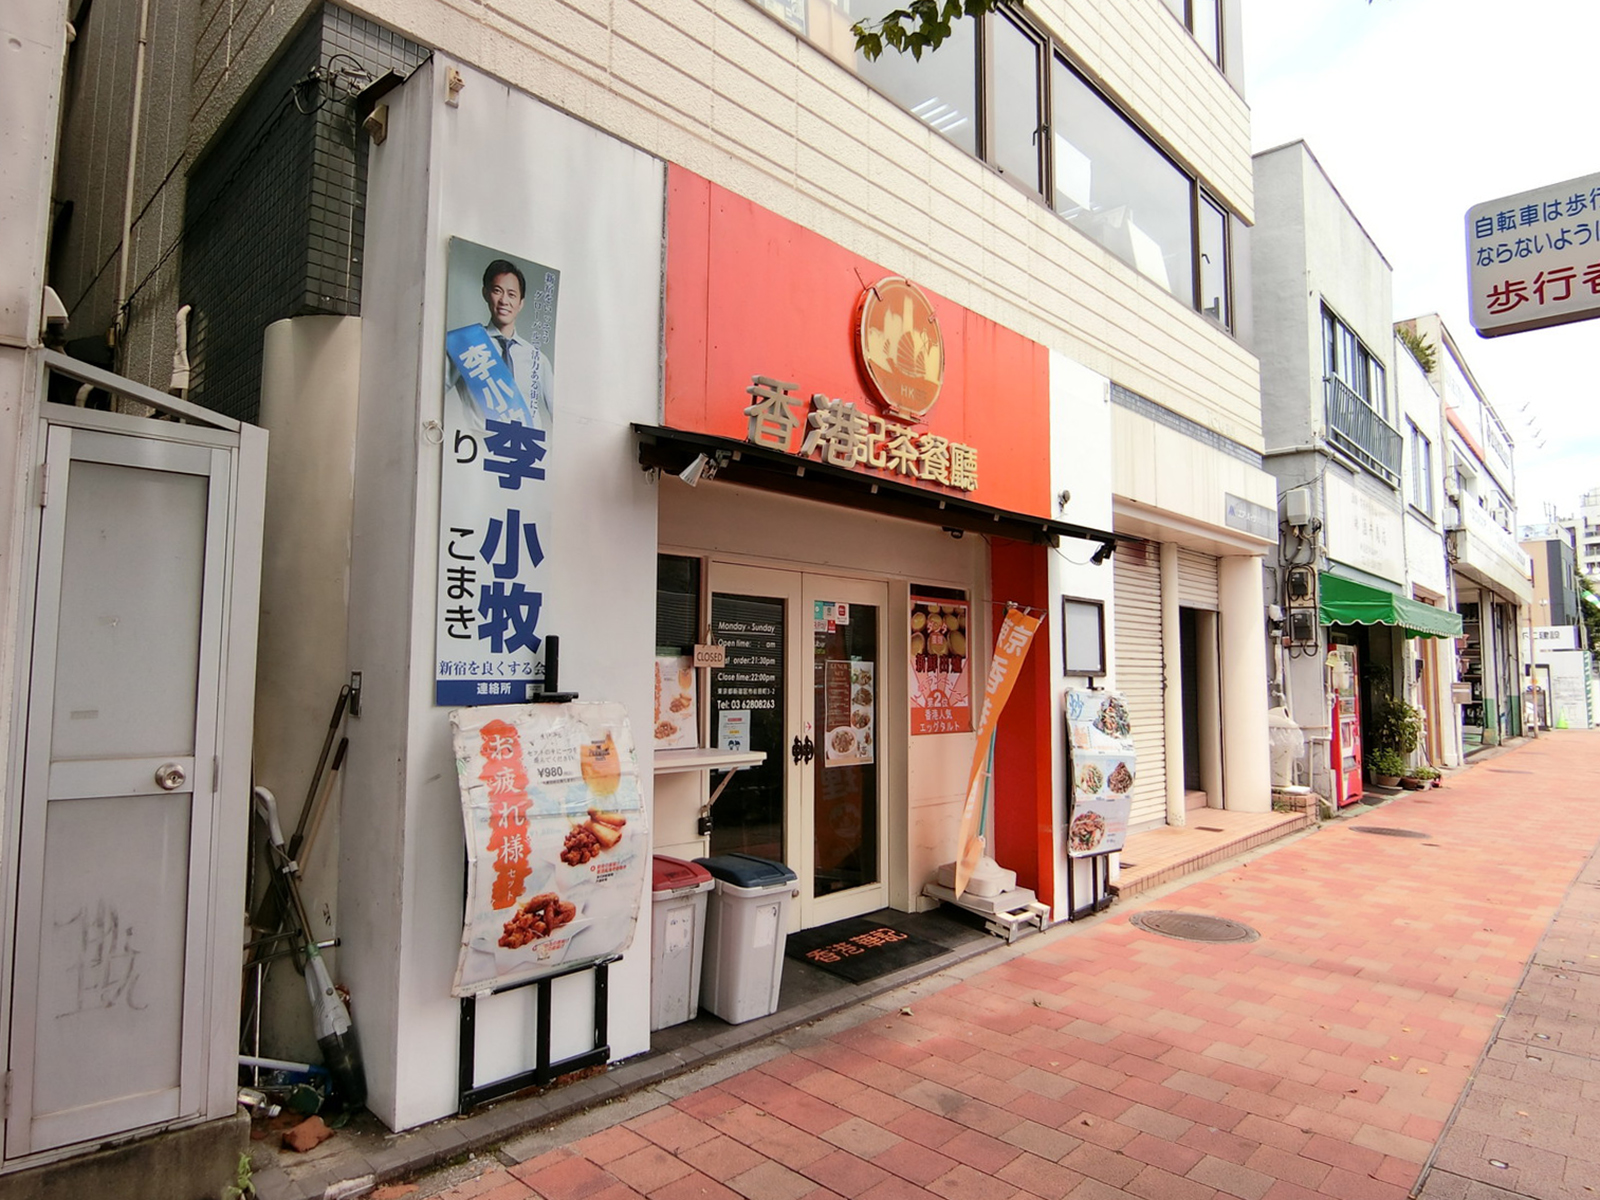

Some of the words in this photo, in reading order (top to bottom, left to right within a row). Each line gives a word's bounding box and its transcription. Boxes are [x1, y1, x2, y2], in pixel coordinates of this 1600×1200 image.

[1476, 220, 1600, 267] ならないよう
[900, 384, 915, 400] HK
[454, 429, 478, 464] り
[444, 527, 477, 639] こまき
[719, 621, 747, 632] Monday
[751, 623, 776, 634] Sunday
[717, 638, 736, 648] Open
[696, 651, 723, 663] CLOSED
[439, 660, 546, 677] 新宿を良くする会
[717, 672, 735, 681] Close
[476, 682, 512, 695] 連絡所
[717, 700, 730, 709] Tel:
[731, 699, 740, 709] 03
[741, 699, 775, 709] 62808263
[920, 721, 960, 732] エッグタルト
[537, 766, 563, 778] ¥980
